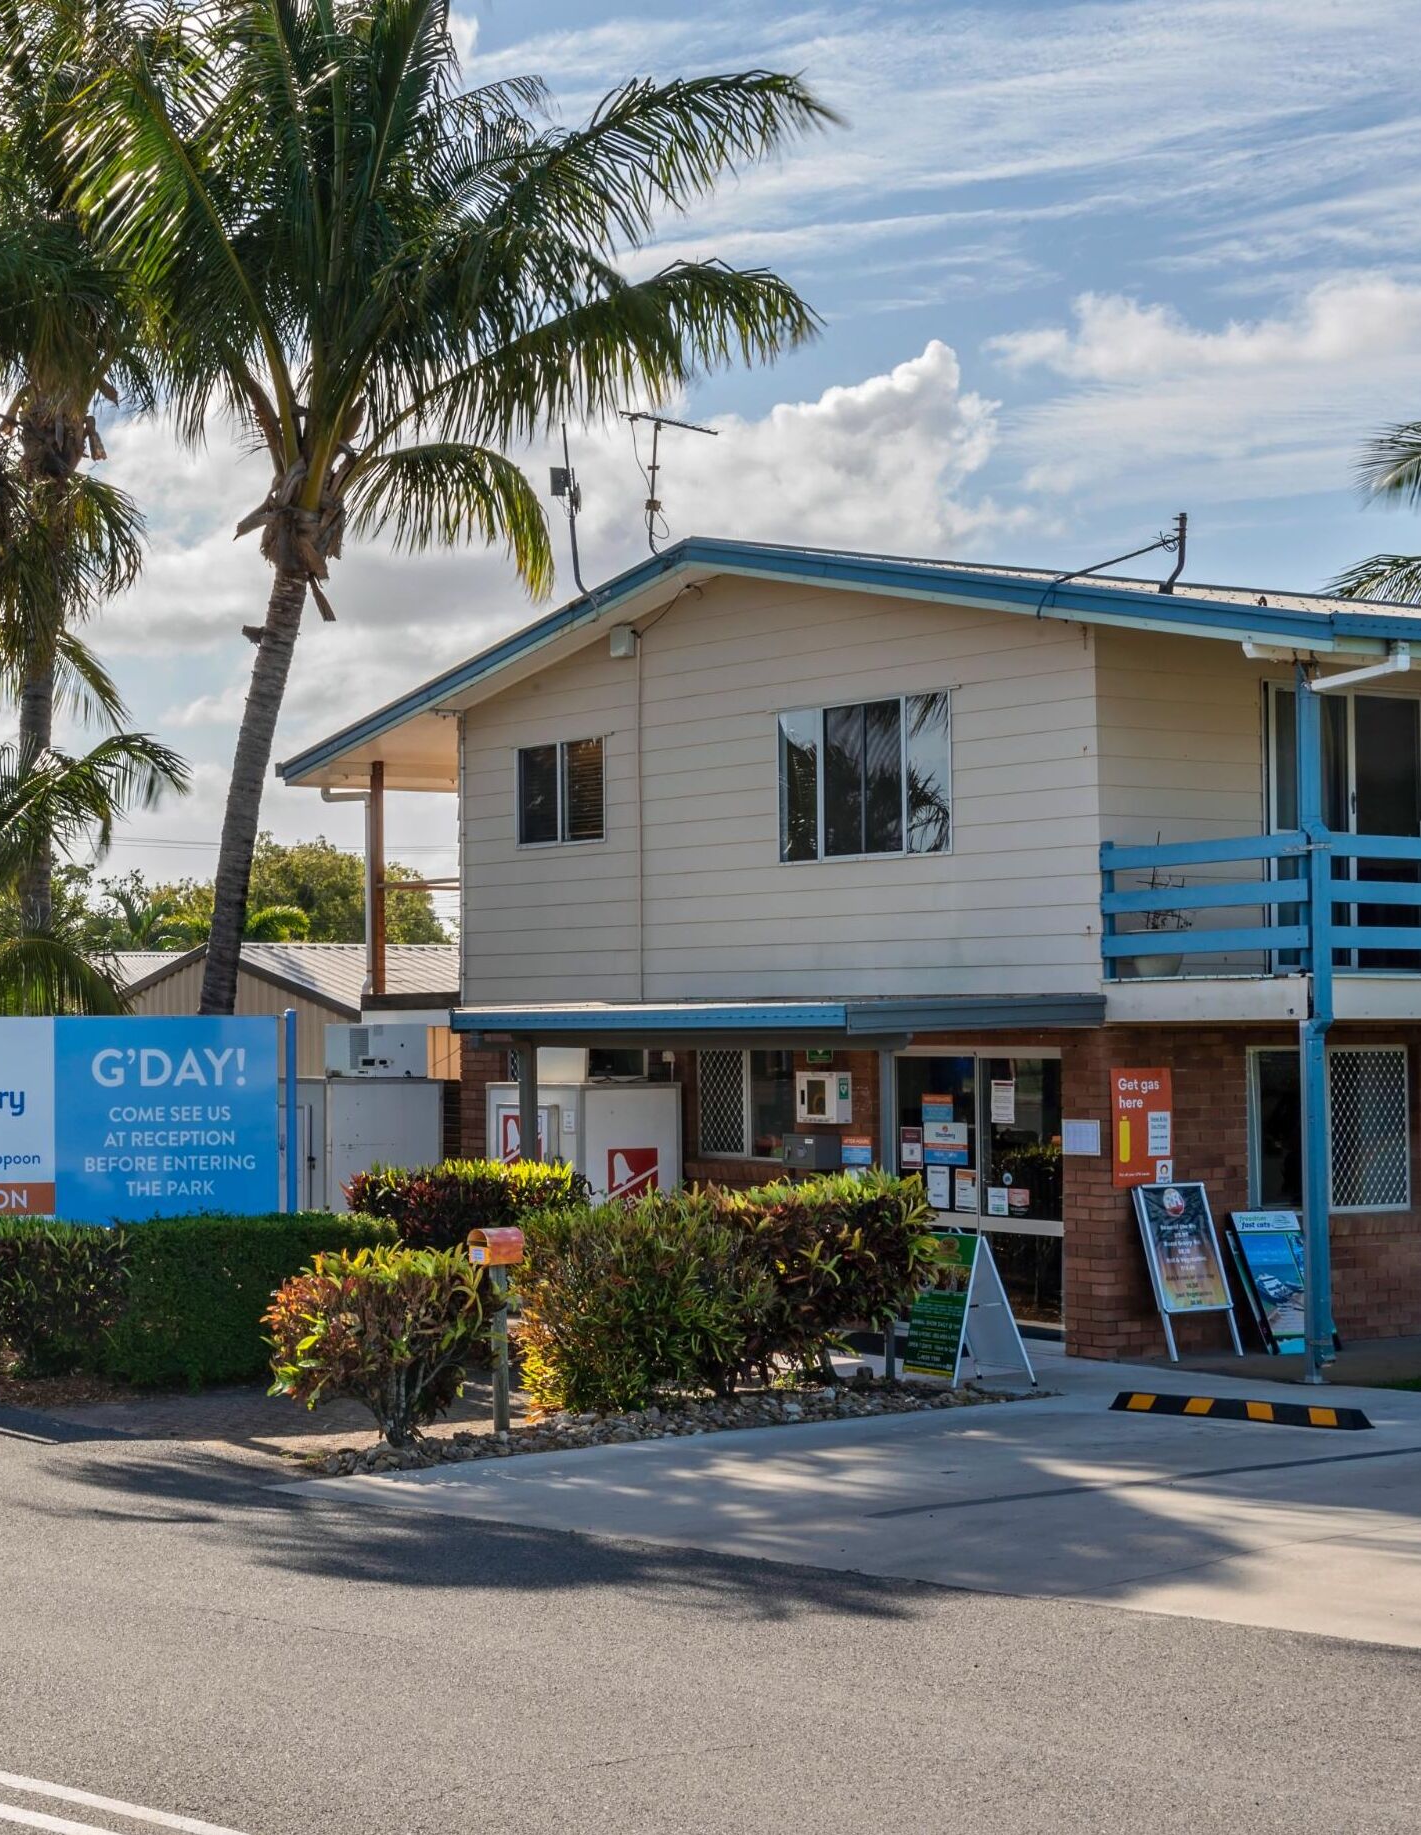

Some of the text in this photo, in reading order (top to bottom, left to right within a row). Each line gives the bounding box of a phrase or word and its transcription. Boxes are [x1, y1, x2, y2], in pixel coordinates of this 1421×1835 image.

[1117, 1077, 1160, 1094] Get gas
[1118, 1095, 1144, 1109] here
[108, 1105, 231, 1123] COME SEE US
[103, 1130, 235, 1148] AT RECEPTION
[83, 1154, 256, 1173] BEFORE ENTERING
[126, 1180, 214, 1197] THE PARK
